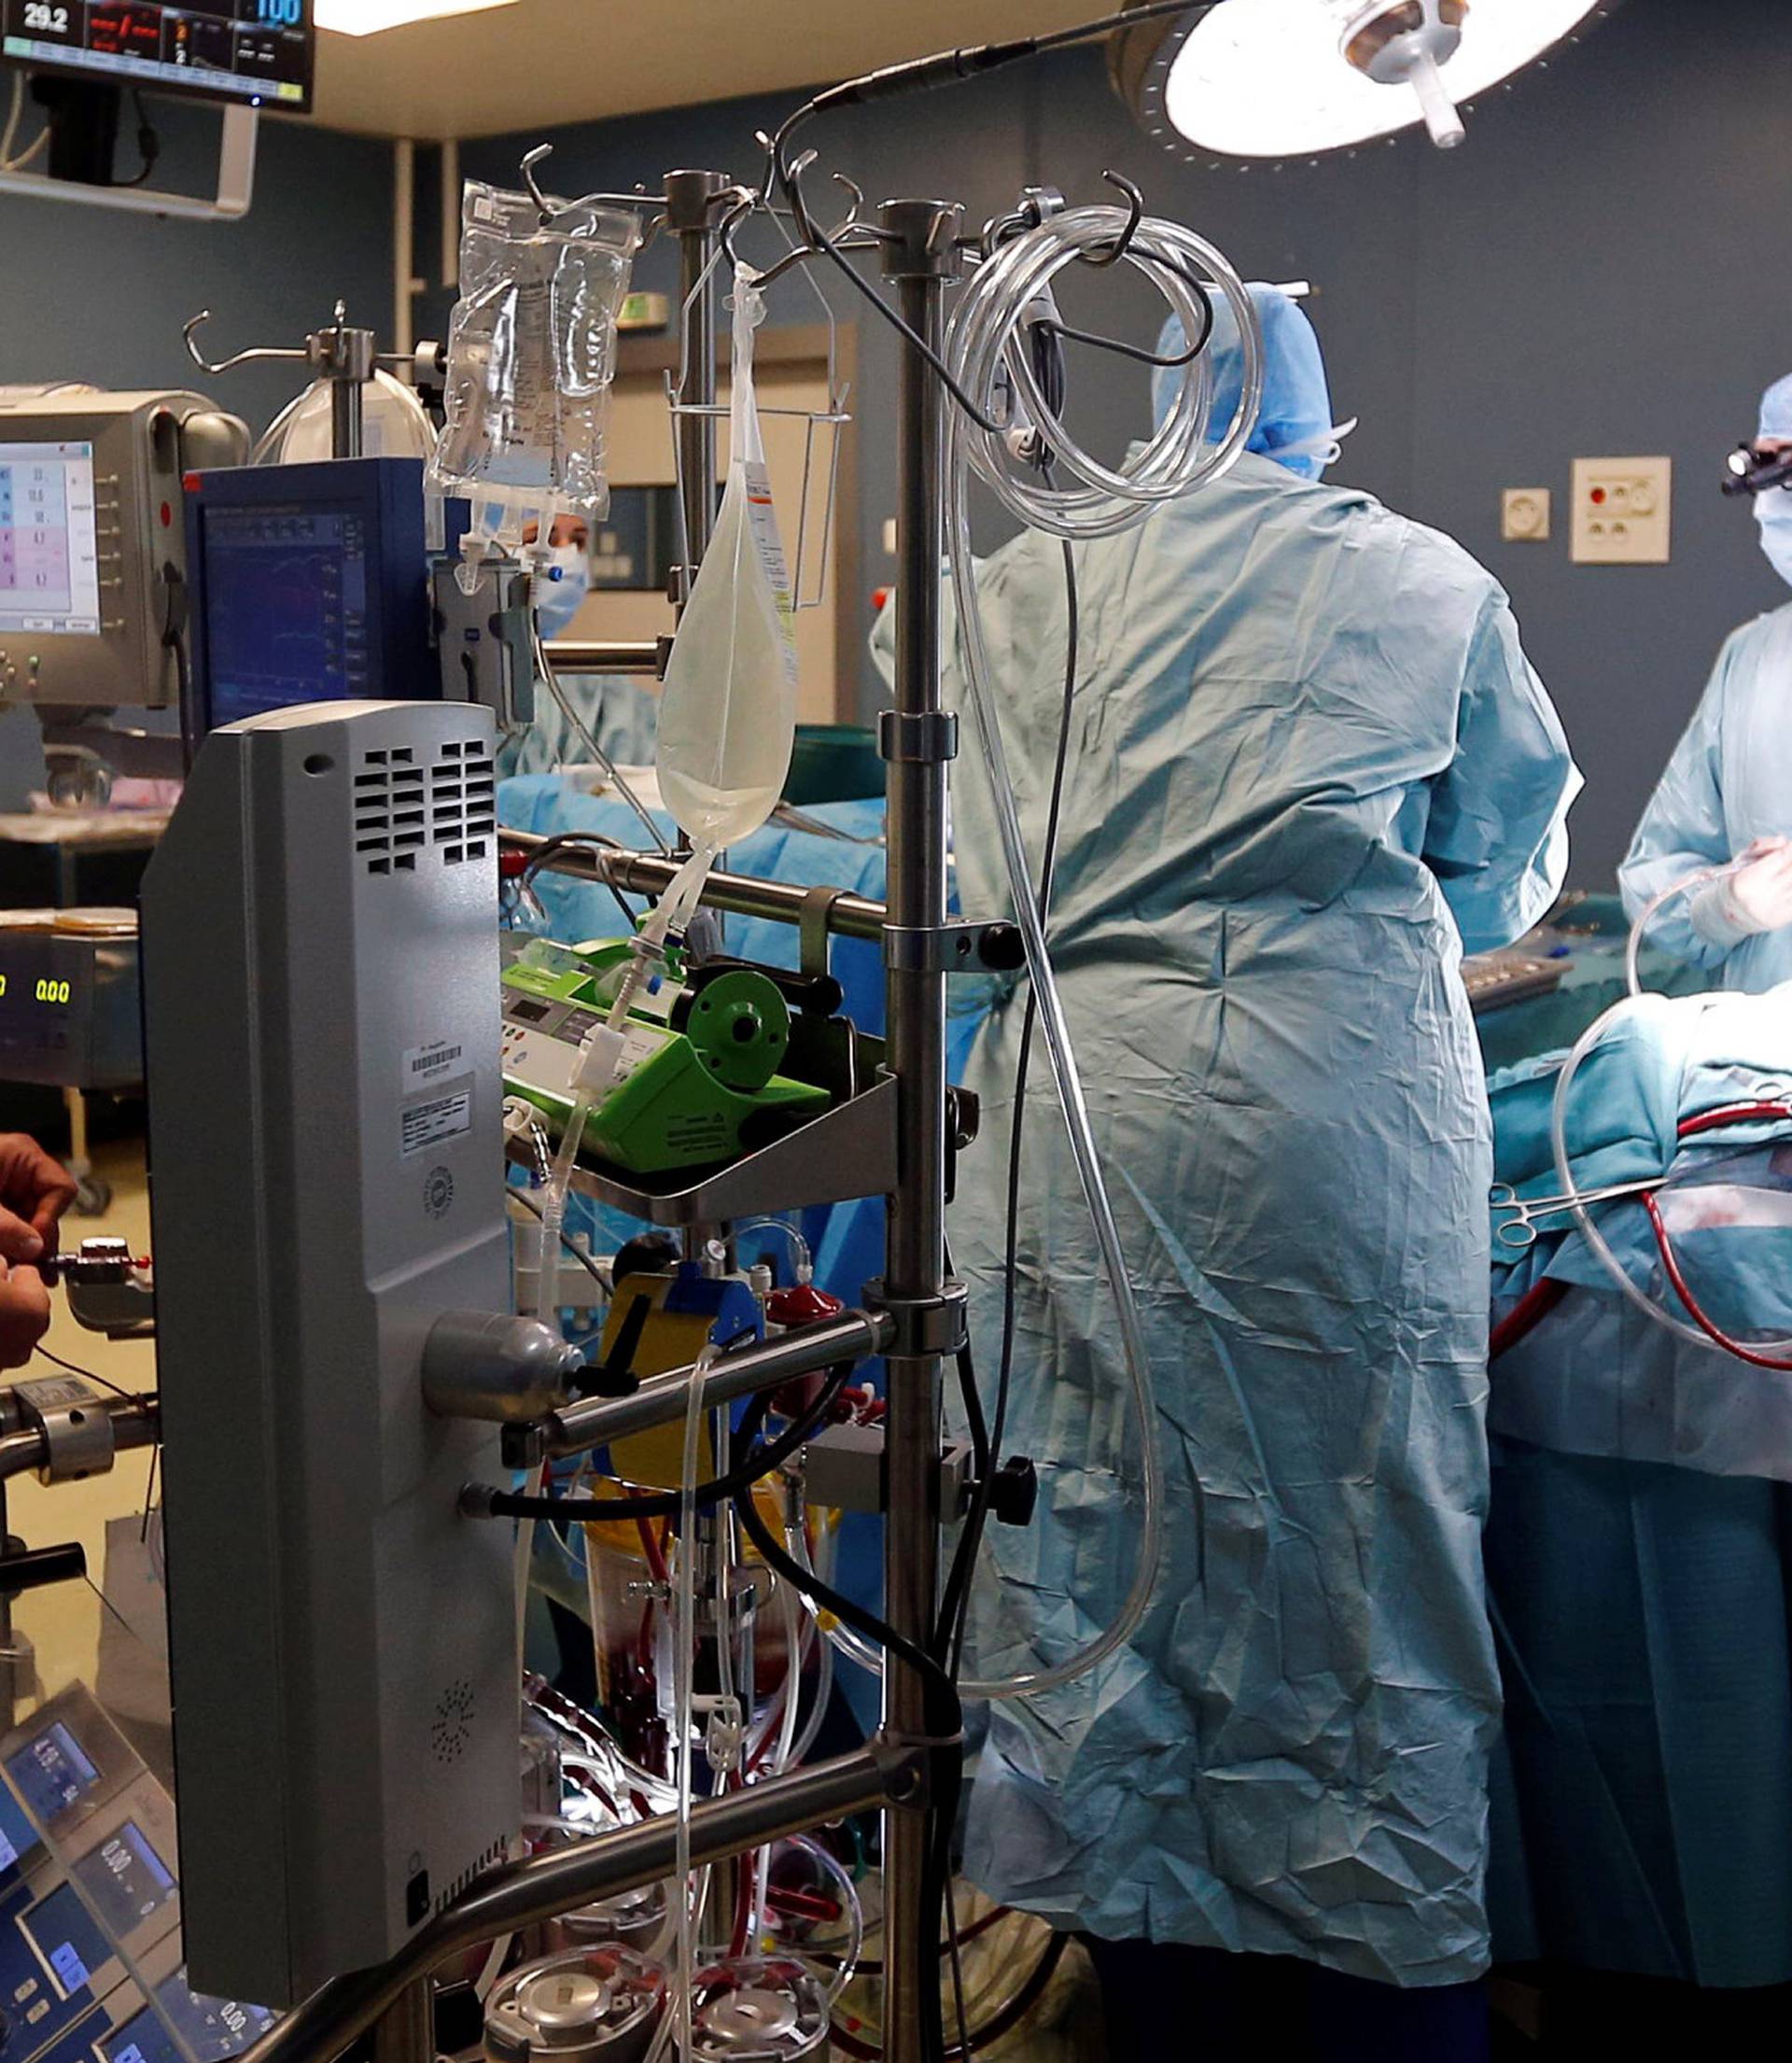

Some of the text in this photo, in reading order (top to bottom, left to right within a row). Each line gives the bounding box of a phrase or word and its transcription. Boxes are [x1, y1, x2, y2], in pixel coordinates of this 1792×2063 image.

[24, 3, 67, 33] 29.2
[101, 1839, 133, 1874] 0.00
[220, 2001, 247, 2031] 0.00
